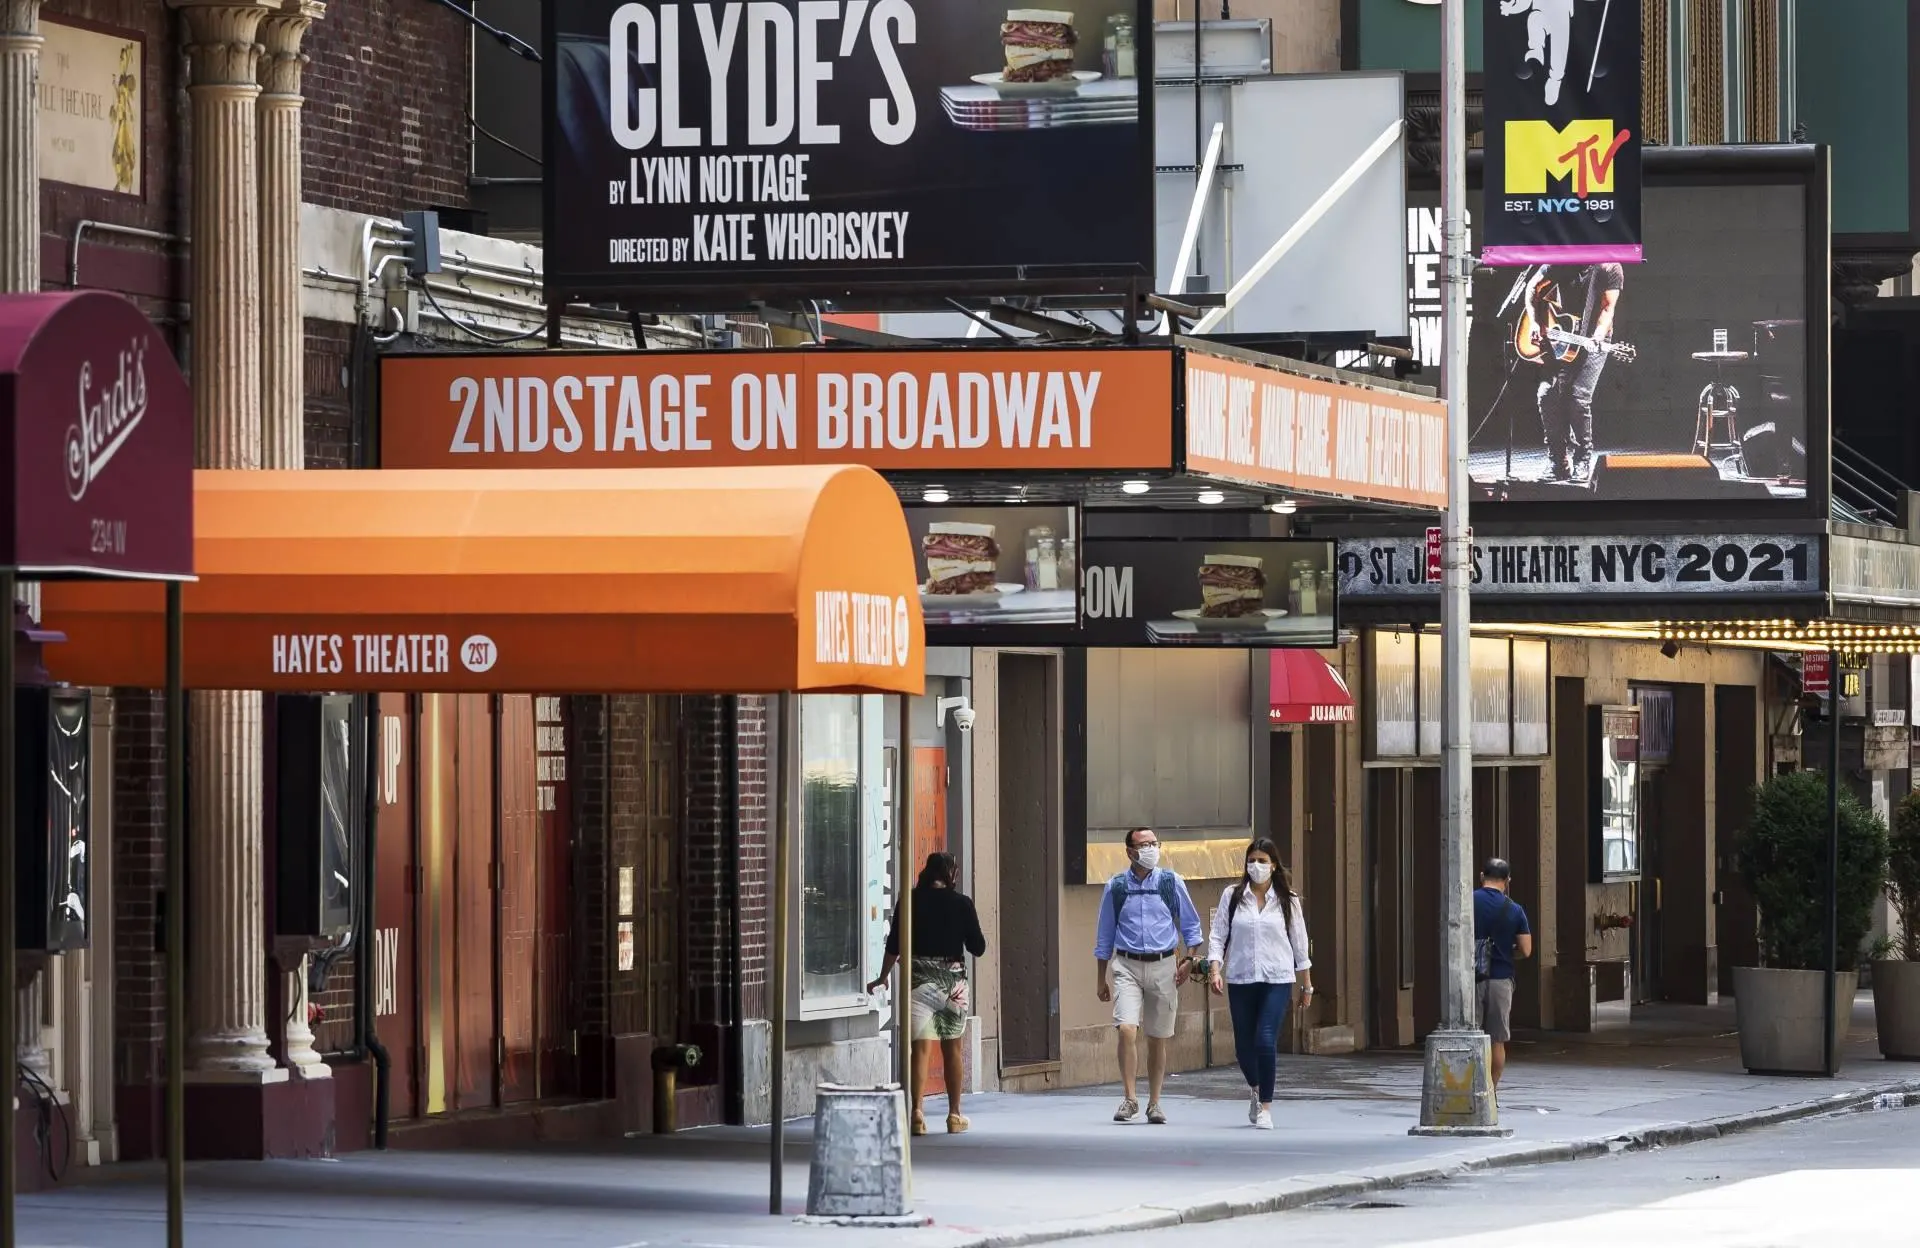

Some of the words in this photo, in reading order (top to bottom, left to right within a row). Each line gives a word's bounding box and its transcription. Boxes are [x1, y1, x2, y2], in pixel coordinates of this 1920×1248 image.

[610, 0, 917, 149] CLYDE'S
[60, 87, 105, 121] THEATRE
[609, 181, 626, 204] BY
[630, 156, 691, 204] LYNN
[699, 154, 810, 203] NOTTAGE
[1505, 119, 1631, 199] MTV
[1504, 200, 1534, 212] EST.
[1537, 198, 1581, 213] NYC
[1584, 199, 1614, 211] 1981
[609, 237, 668, 264] DIRECTED
[672, 236, 689, 263] BY
[693, 214, 756, 262] KATE
[763, 210, 909, 261] WHORISKEY
[448, 374, 712, 454] 2NDSTAGE
[731, 373, 797, 451] ON
[817, 371, 1103, 450] BROADWAY
[90, 518, 113, 553] 234
[1369, 546, 1400, 585] ST.
[1488, 545, 1580, 584] THEATRE
[1591, 543, 1666, 583] NYC
[1676, 542, 1808, 583] 2021
[1080, 566, 1134, 619] OM
[272, 634, 342, 674] HAYES
[352, 633, 449, 673] THEATER
[468, 642, 491, 665] 2ST
[815, 589, 850, 664] HAYES
[851, 592, 893, 667] THEATER
[383, 715, 402, 804] UP
